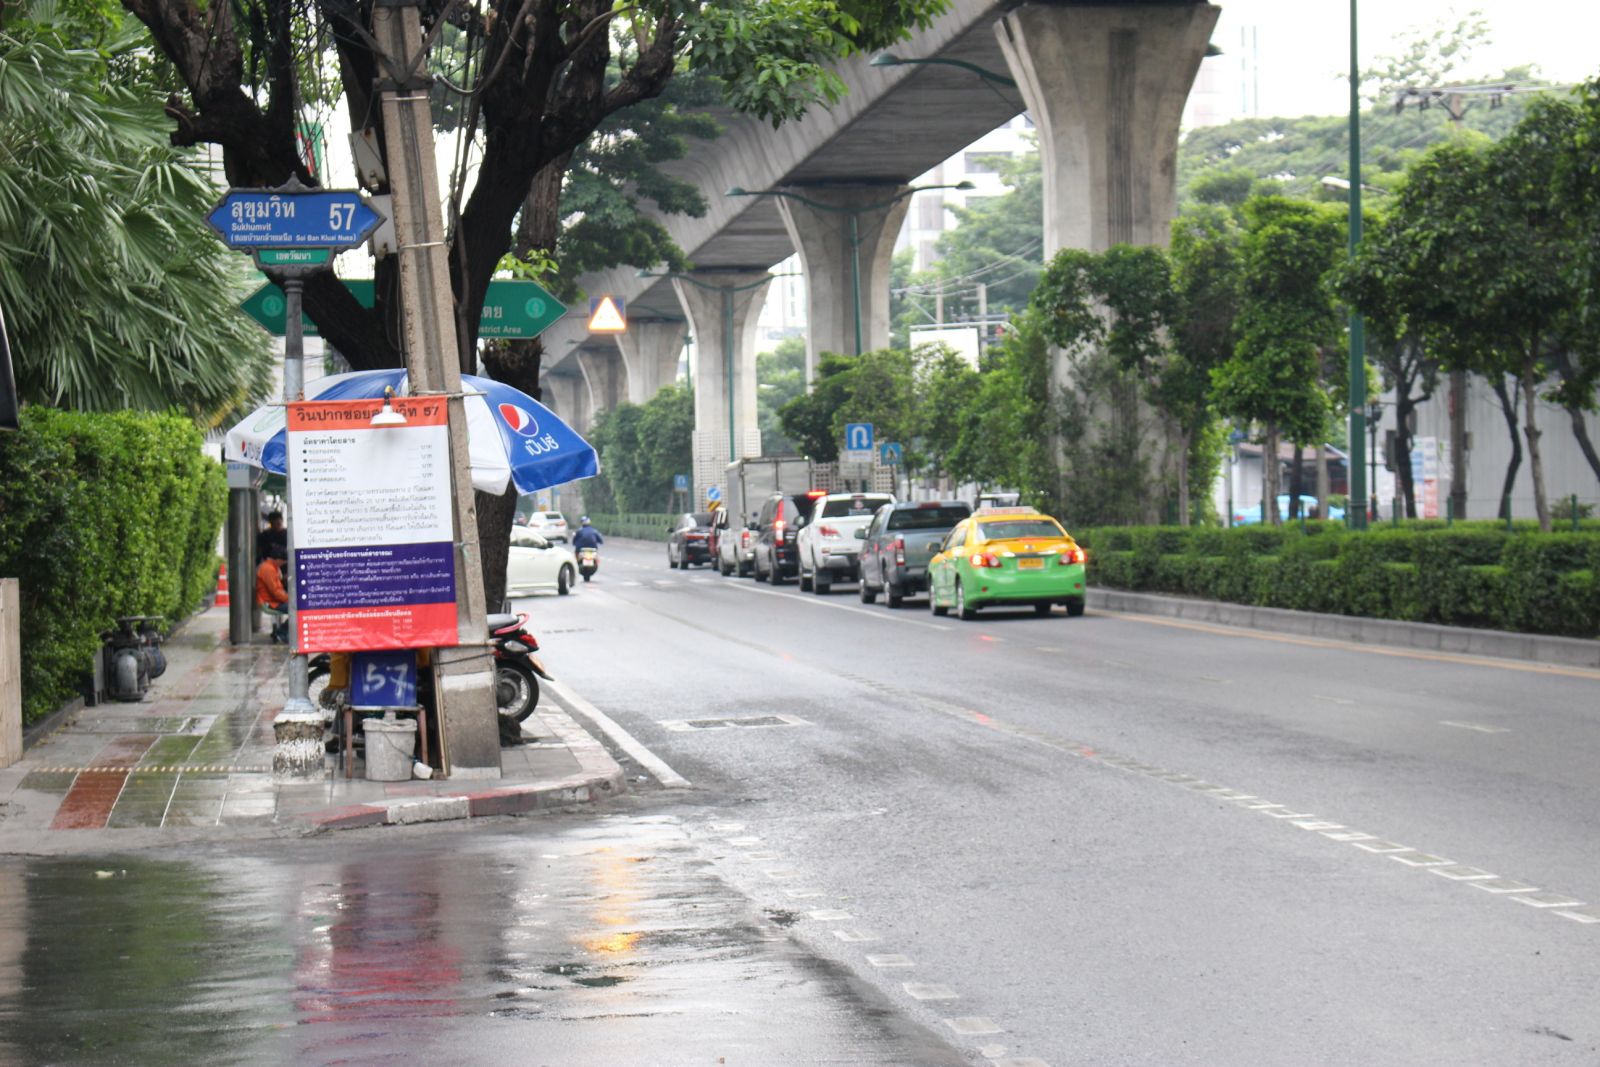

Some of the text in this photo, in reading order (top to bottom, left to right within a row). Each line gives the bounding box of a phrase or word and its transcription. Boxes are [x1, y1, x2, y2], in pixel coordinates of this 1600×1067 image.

[231, 195, 356, 230] สุขุมวิท 57
[231, 222, 272, 231] Sukhumvit
[503, 325, 522, 334] Area
[424, 406, 440, 418] 57
[362, 662, 414, 699] 57
